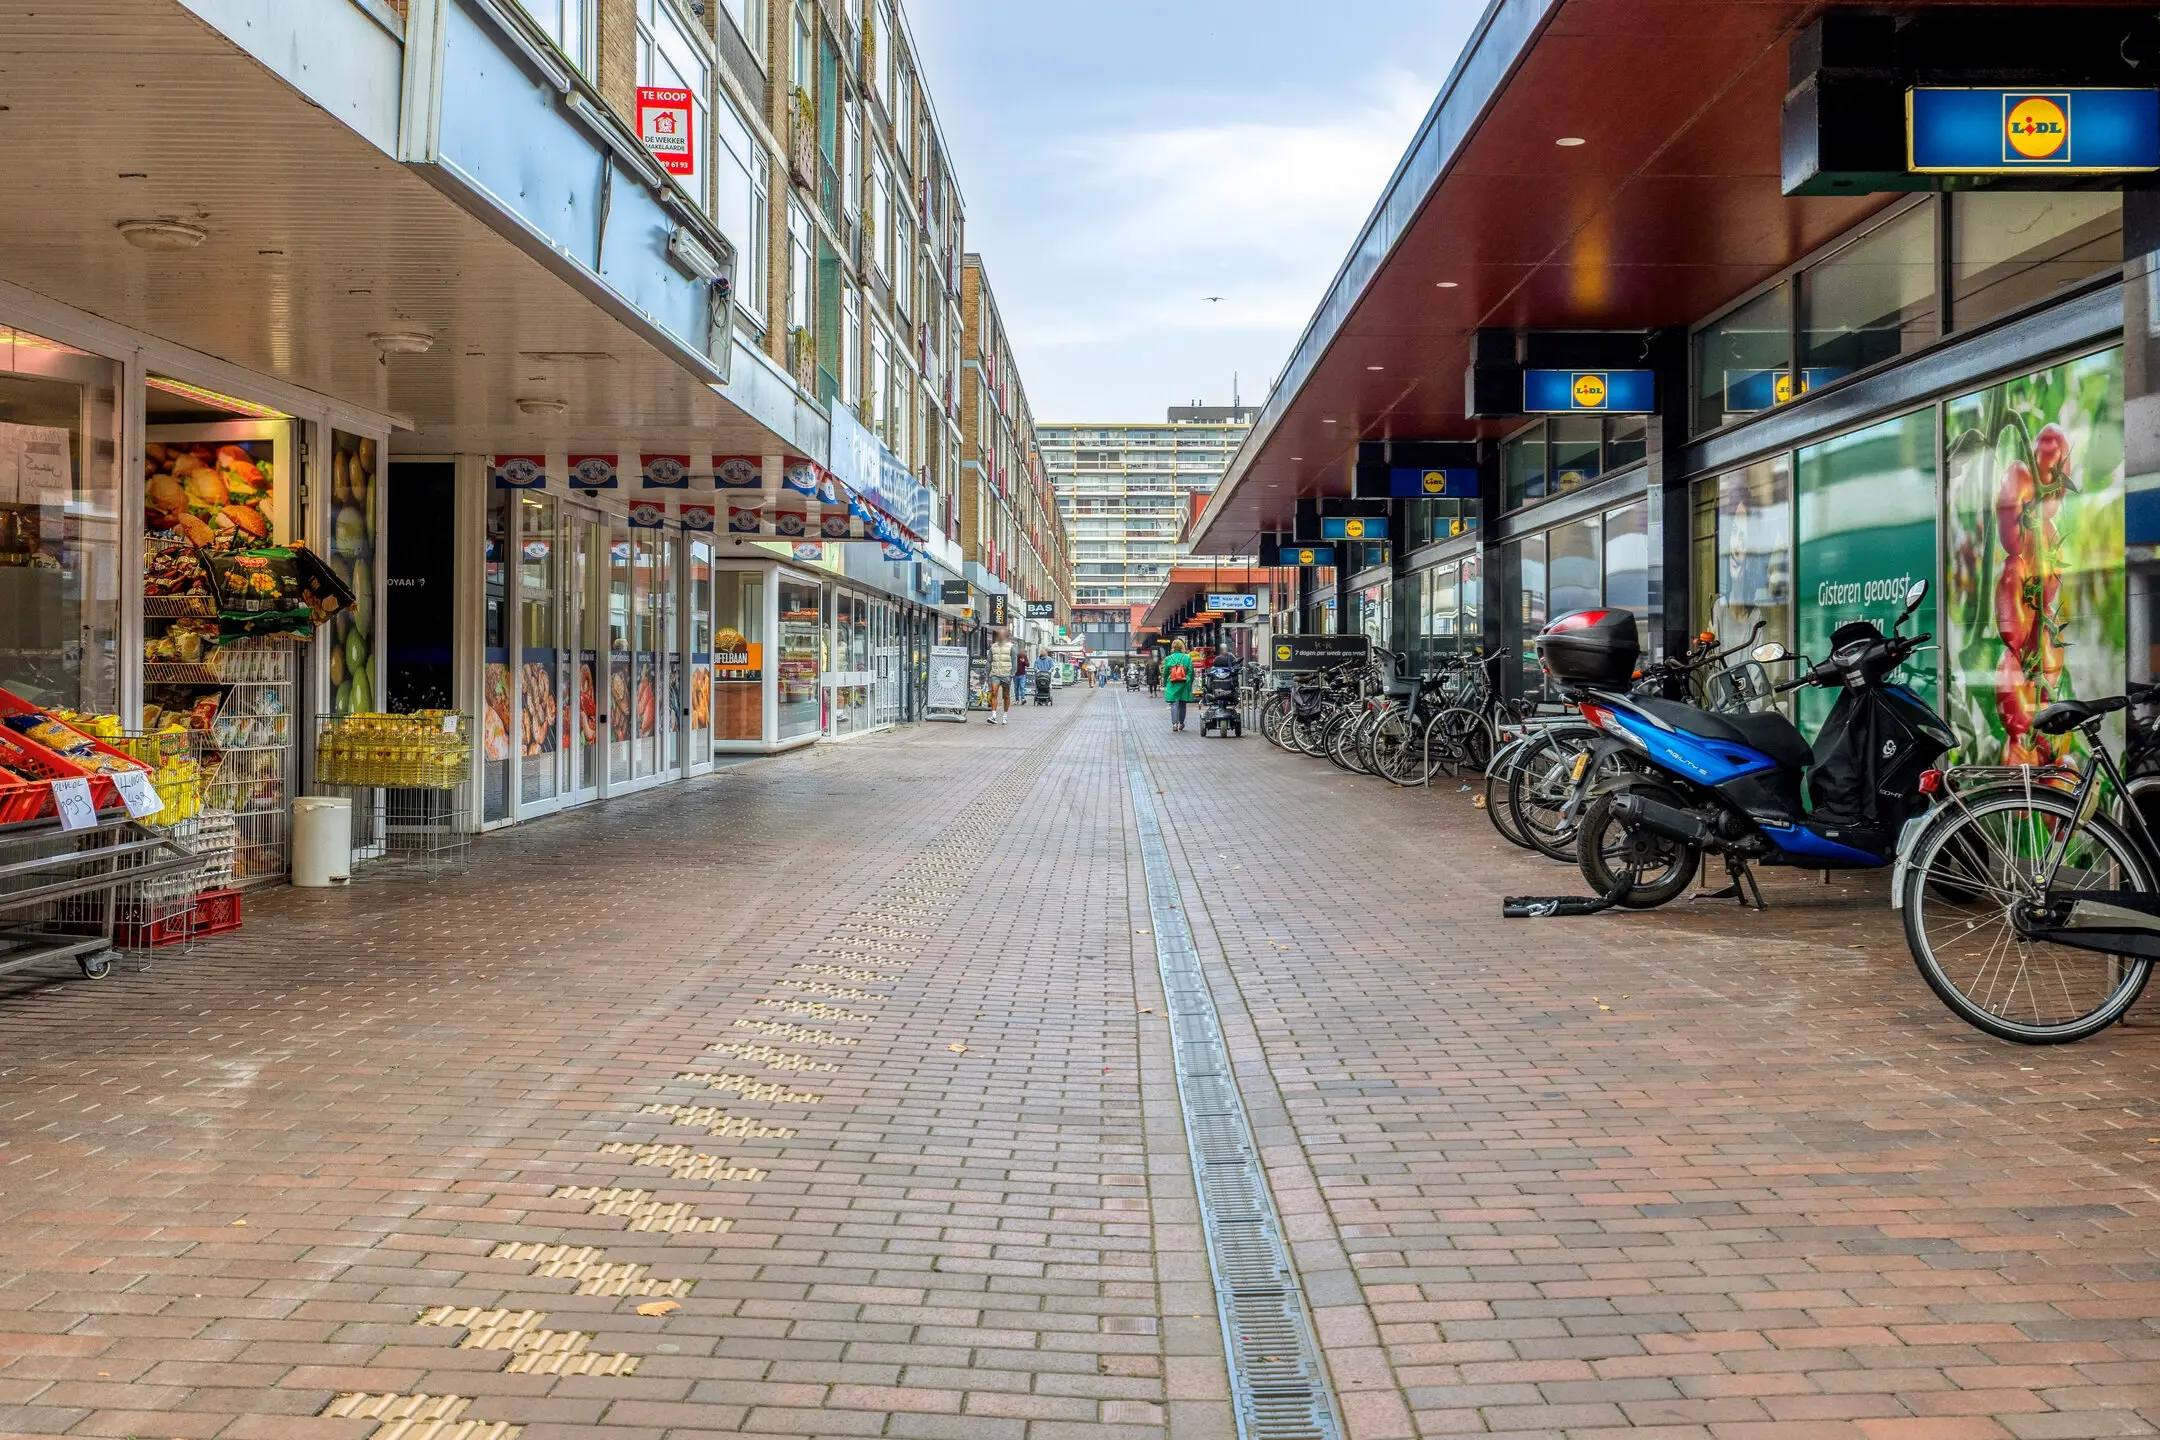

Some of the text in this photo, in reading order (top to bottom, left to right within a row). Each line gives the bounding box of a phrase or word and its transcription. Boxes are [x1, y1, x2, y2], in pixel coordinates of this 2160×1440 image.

[642, 91, 687, 102] TE KOOP
[1818, 572, 1910, 607] Gisteren geoogst
[1027, 604, 1053, 612] BAS
